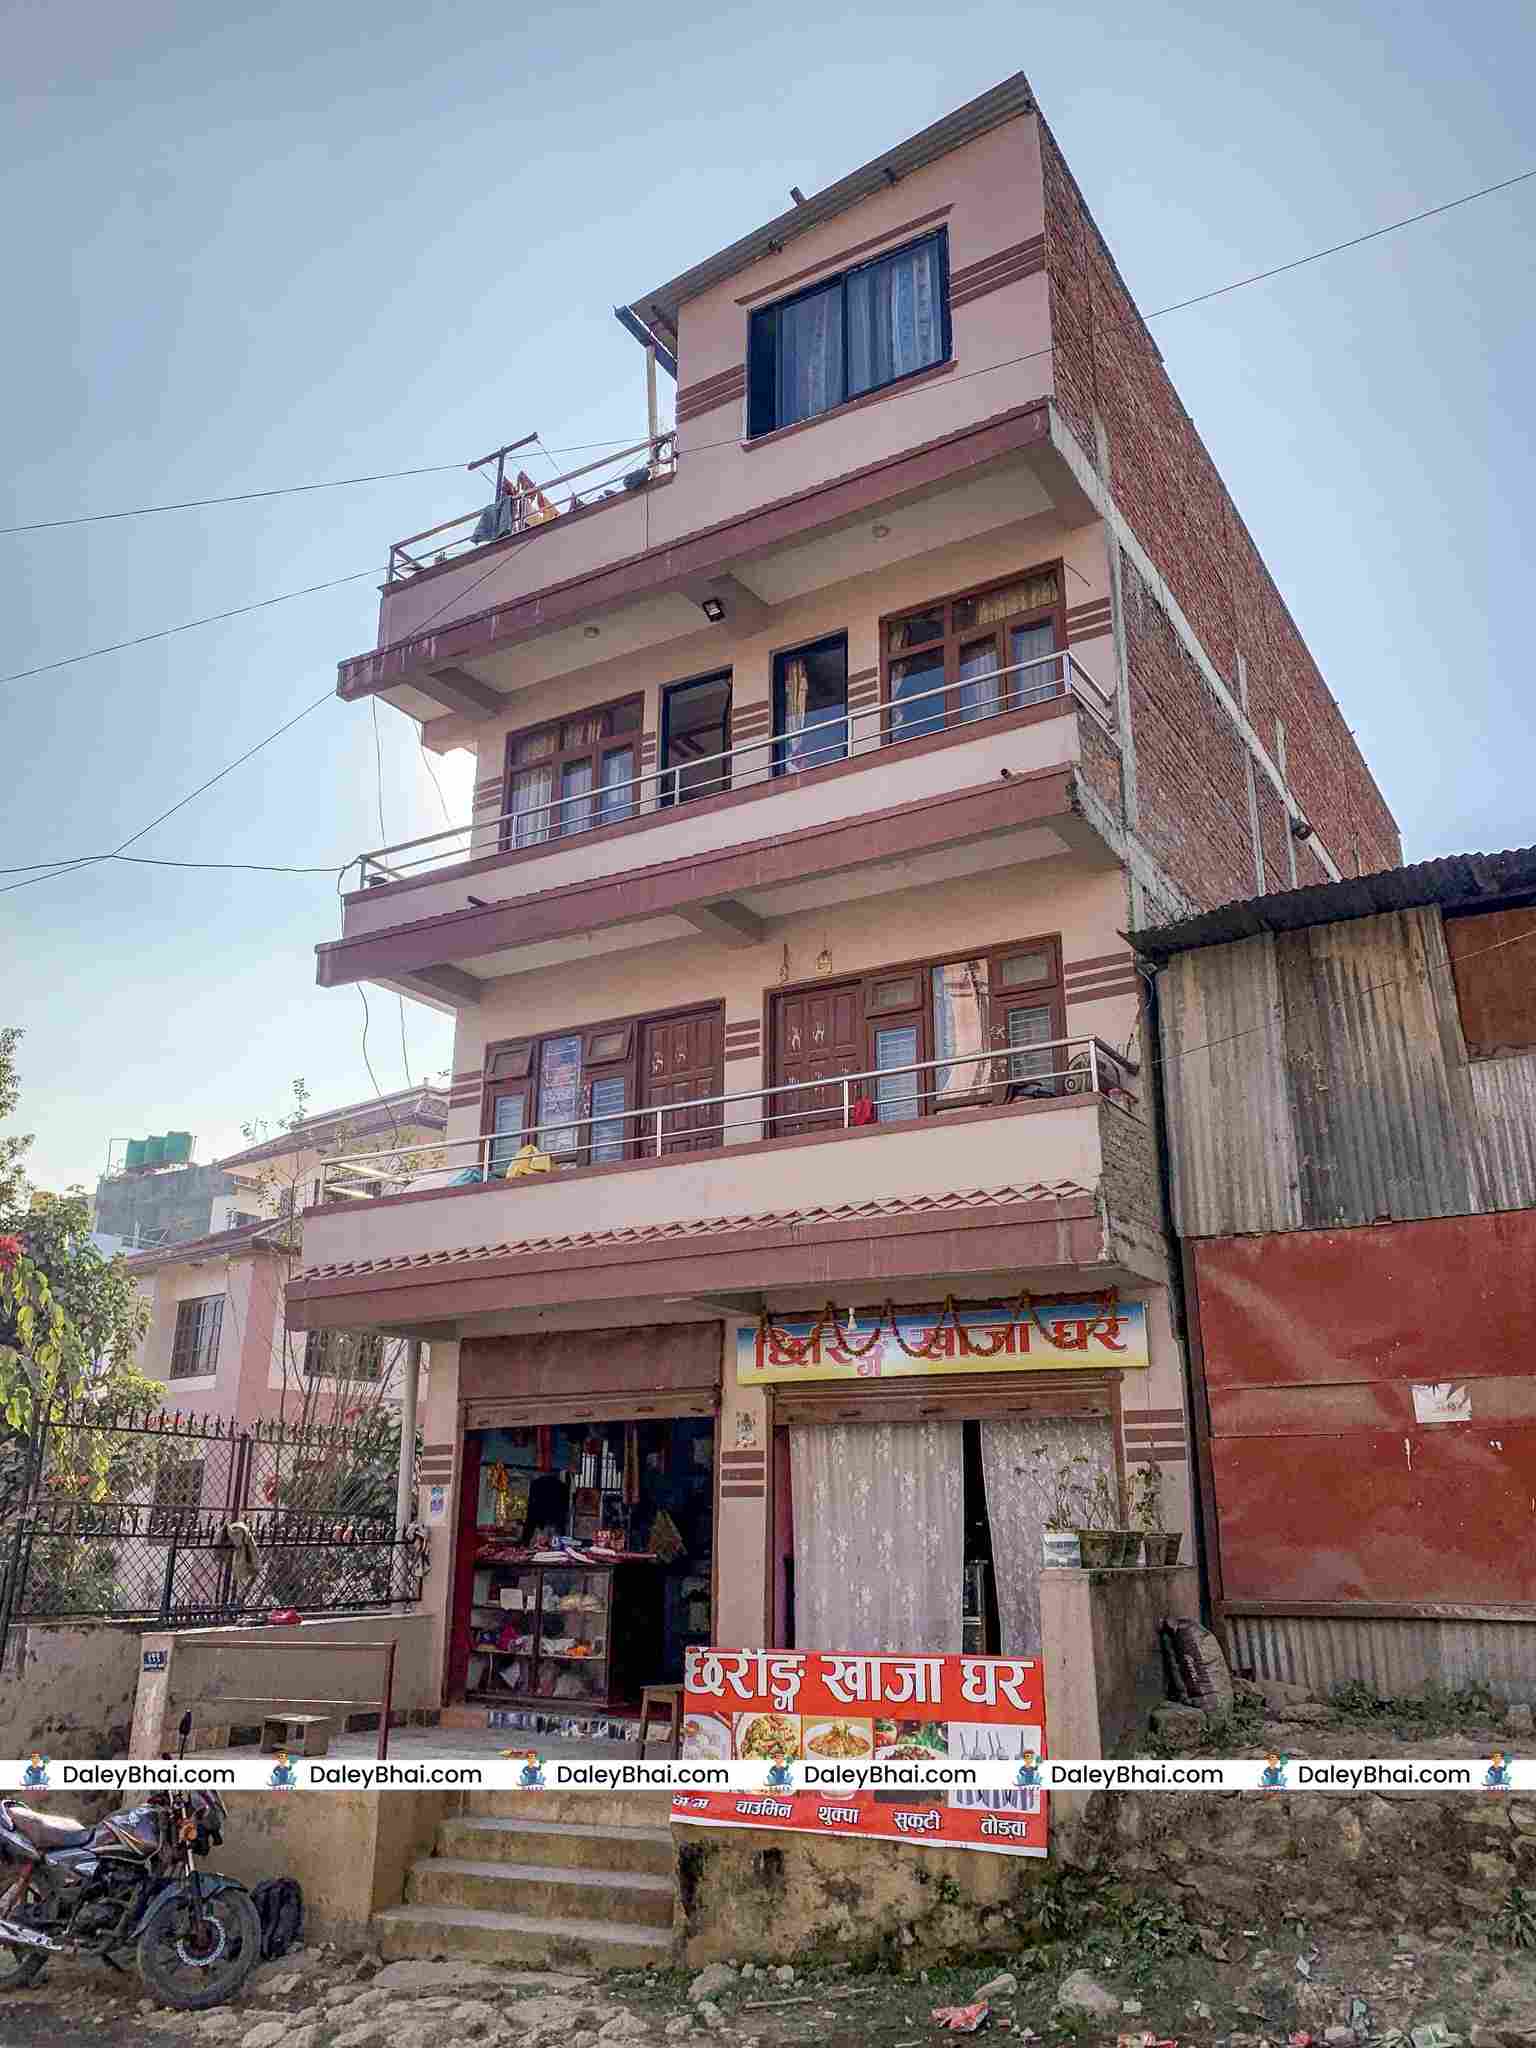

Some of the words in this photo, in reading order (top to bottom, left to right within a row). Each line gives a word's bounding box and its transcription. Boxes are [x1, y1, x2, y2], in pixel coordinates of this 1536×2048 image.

[820, 1655, 945, 1704] खाजा
[960, 1658, 1034, 1710] घर
[735, 1797, 793, 1819] चाउमिन
